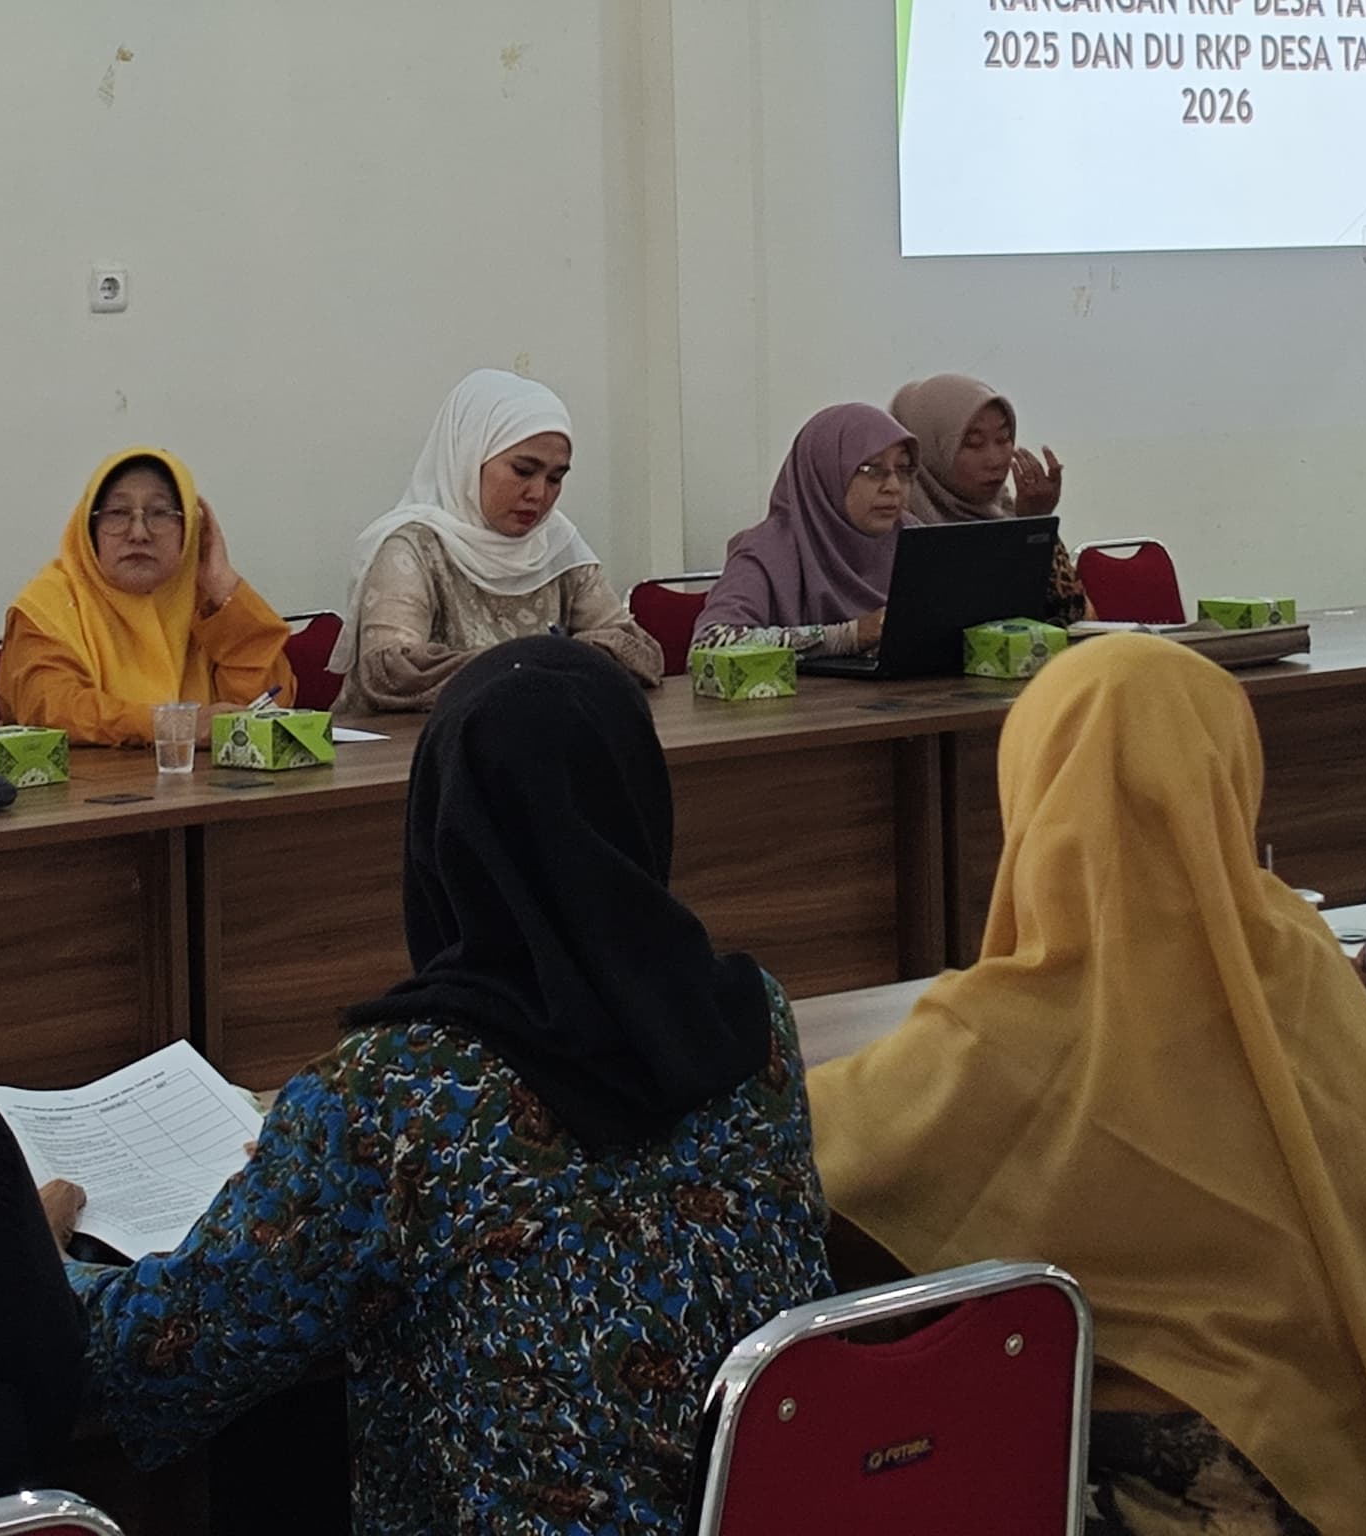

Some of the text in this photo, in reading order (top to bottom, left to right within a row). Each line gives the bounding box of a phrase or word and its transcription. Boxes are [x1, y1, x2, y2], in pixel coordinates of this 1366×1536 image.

[983, 31, 1059, 69] 2025
[1071, 32, 1134, 69] DAN
[1144, 33, 1184, 69] DU
[1195, 35, 1251, 70] RKP
[1261, 36, 1331, 71] DESA
[1182, 88, 1253, 123] 2026
